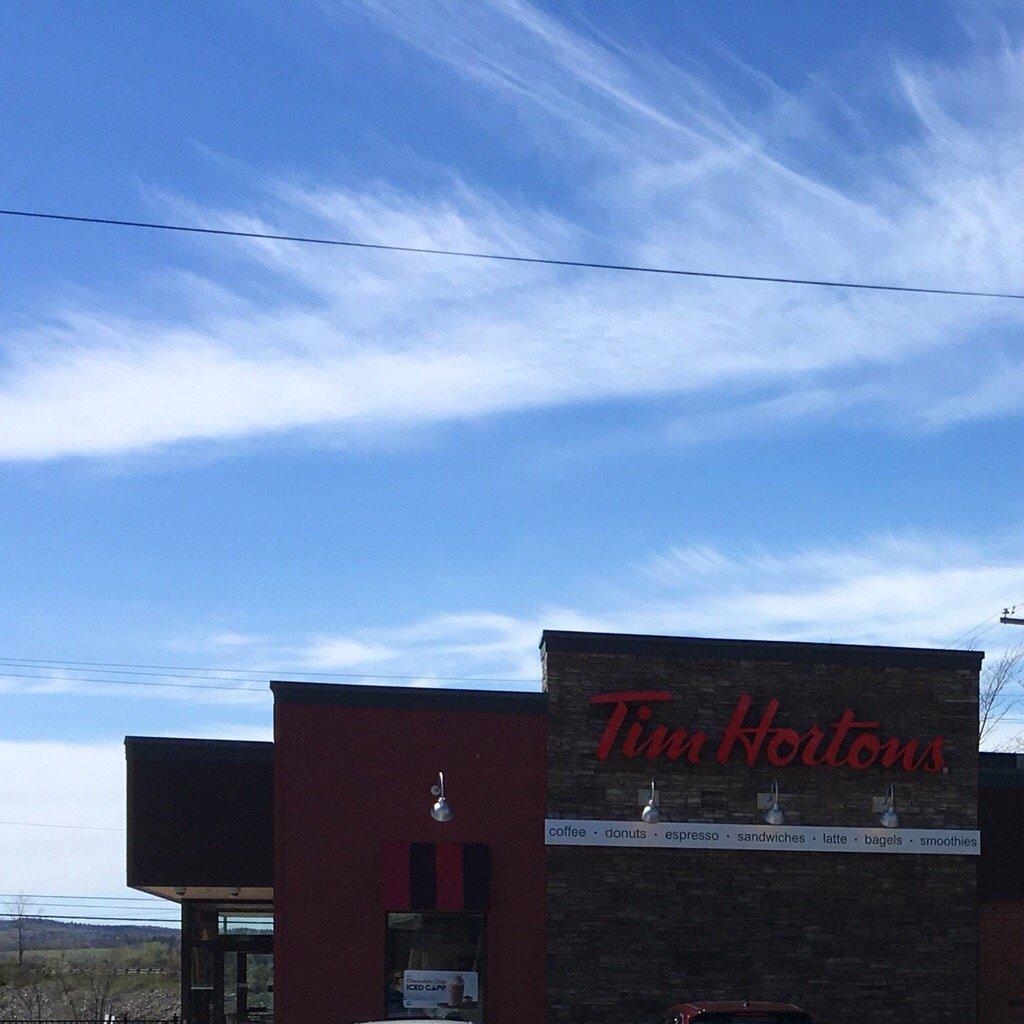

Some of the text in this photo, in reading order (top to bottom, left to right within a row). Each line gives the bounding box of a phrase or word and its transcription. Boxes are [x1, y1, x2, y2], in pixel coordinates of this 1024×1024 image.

[588, 691, 944, 774] Tim Hortons
[549, 825, 977, 848] coffee donuts espresso sandwiches latte bagels smoothies
